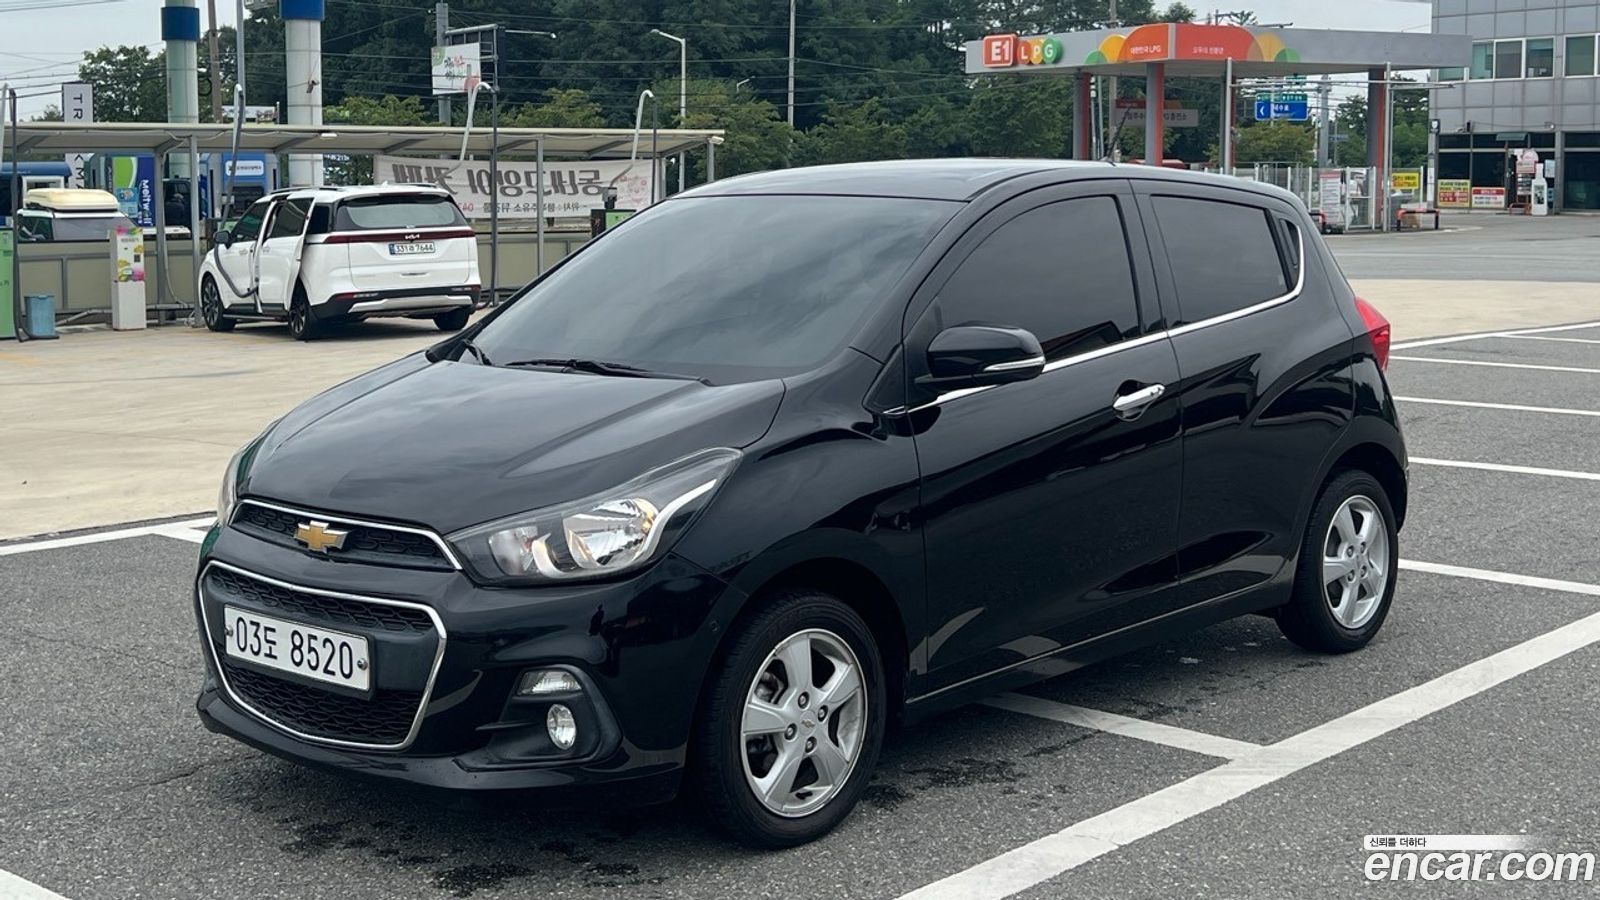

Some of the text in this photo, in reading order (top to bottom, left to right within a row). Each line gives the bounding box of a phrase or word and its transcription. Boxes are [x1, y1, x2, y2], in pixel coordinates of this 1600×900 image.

[991, 40, 1055, 61] E1 LPG
[236, 616, 354, 680] 03도 8520
